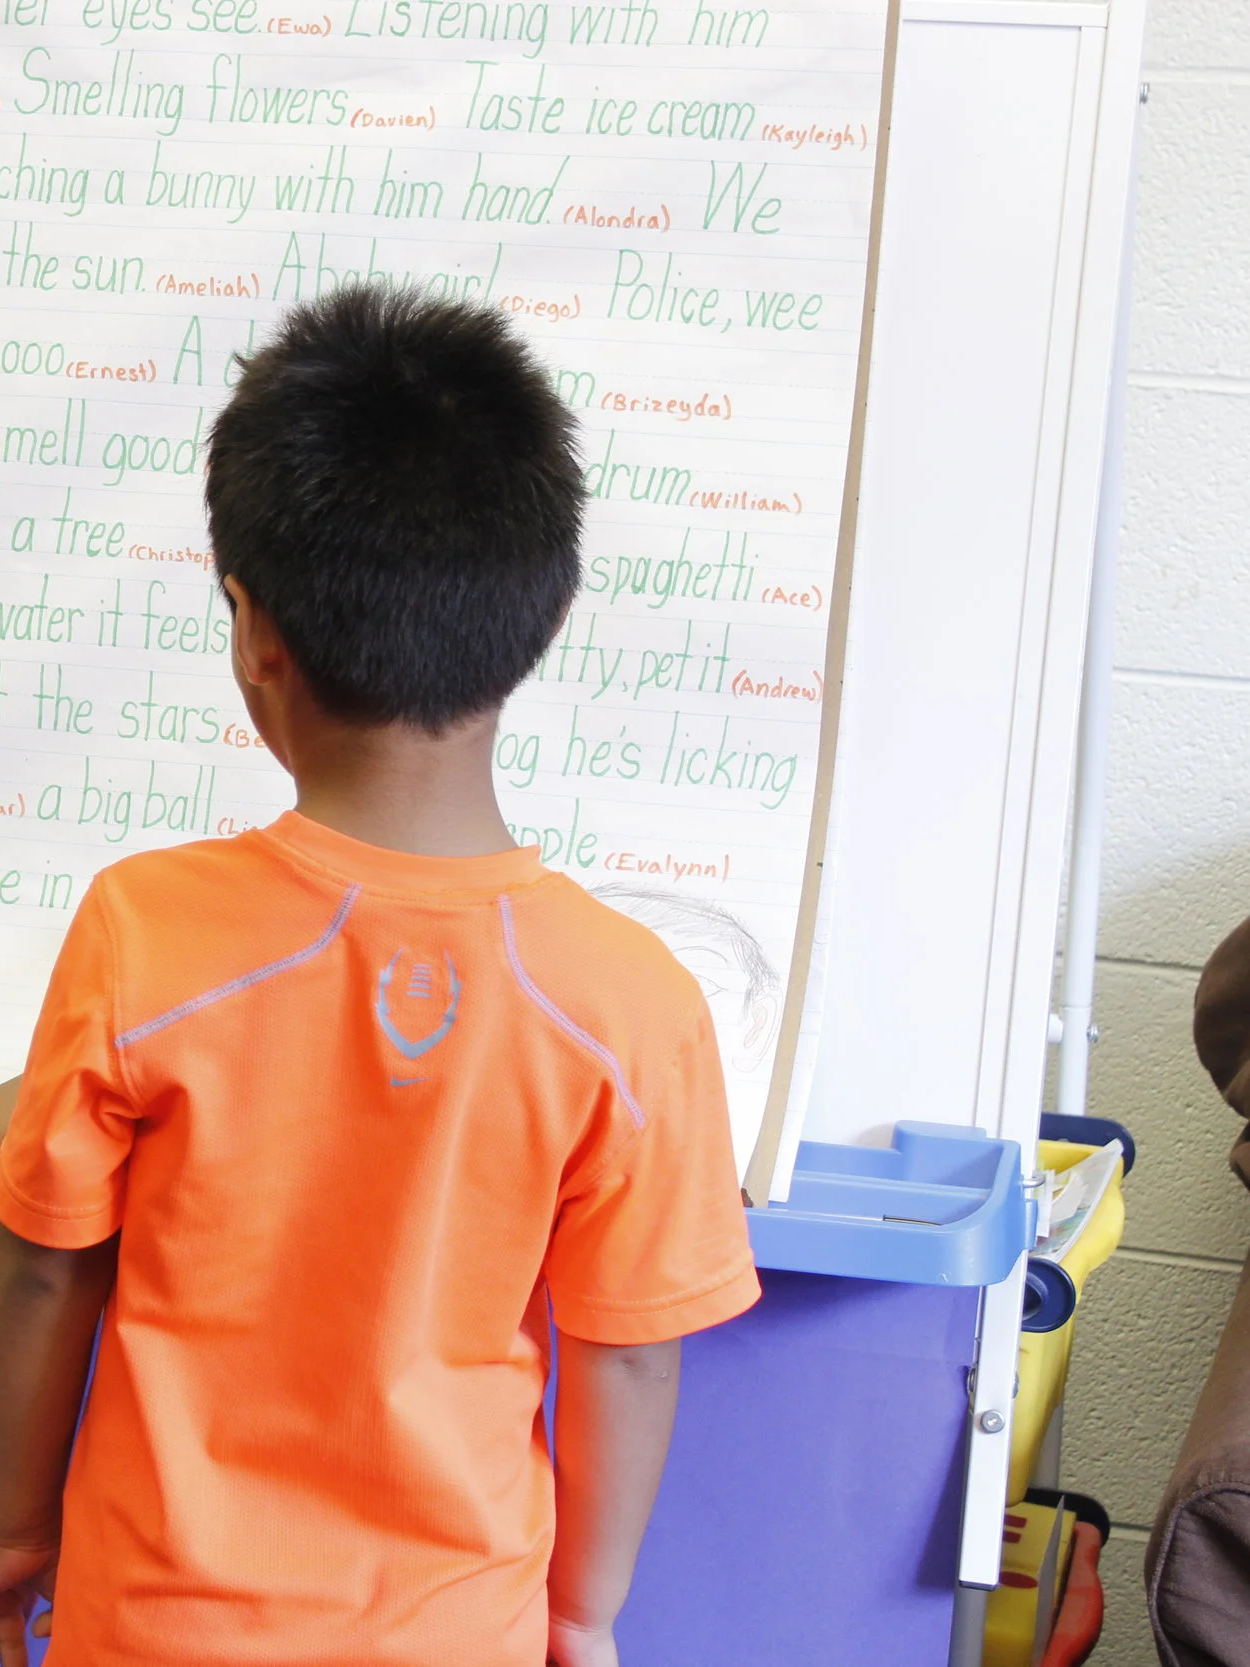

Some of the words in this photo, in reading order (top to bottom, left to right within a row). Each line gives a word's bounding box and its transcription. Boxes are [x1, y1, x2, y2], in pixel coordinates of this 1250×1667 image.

[82, 0, 171, 45] eyes
[187, 0, 262, 33] see.
[267, 15, 333, 37] (Ewa)
[570, 0, 658, 46] with
[687, 0, 771, 47] him
[13, 46, 183, 136] Smelling
[205, 53, 349, 126] flowers
[350, 107, 437, 131] (Davien)
[464, 59, 565, 135] Taste
[584, 86, 636, 136] ice
[648, 100, 756, 142] cream
[761, 123, 868, 151] (Kayleigh)
[102, 167, 126, 205] a
[146, 140, 257, 225] bunny
[274, 144, 355, 214] with
[372, 147, 444, 219] him
[563, 204, 671, 232] (Alondra)
[701, 159, 784, 236] We
[1, 219, 60, 291] the
[72, 254, 147, 294] sun.
[155, 272, 261, 301] (Ameliah)
[272, 230, 306, 302] A
[500, 293, 582, 323] (Diego)
[606, 247, 732, 334] Police,
[745, 289, 824, 331] wee
[0, 341, 66, 376] ooo
[66, 358, 158, 384] (Ernest)
[173, 315, 203, 387] A
[600, 391, 732, 422] (Brizeyda)
[102, 405, 204, 487] good
[584, 427, 692, 506] drum
[688, 489, 805, 517] (William)
[10, 516, 36, 553] a
[52, 486, 127, 558] tree
[583, 526, 759, 610] spaghetti
[761, 584, 823, 612] (Ace)
[98, 577, 125, 647] it
[140, 579, 230, 656] feels
[730, 668, 825, 704] (Andrew)
[33, 663, 95, 735] the
[117, 669, 220, 745] stars
[560, 704, 642, 781] he's
[659, 710, 798, 811] licking
[35, 782, 62, 823] a
[76, 755, 131, 843] big
[141, 759, 216, 836] ball
[603, 851, 730, 883] (Evalynn)
[38, 859, 73, 909] in
